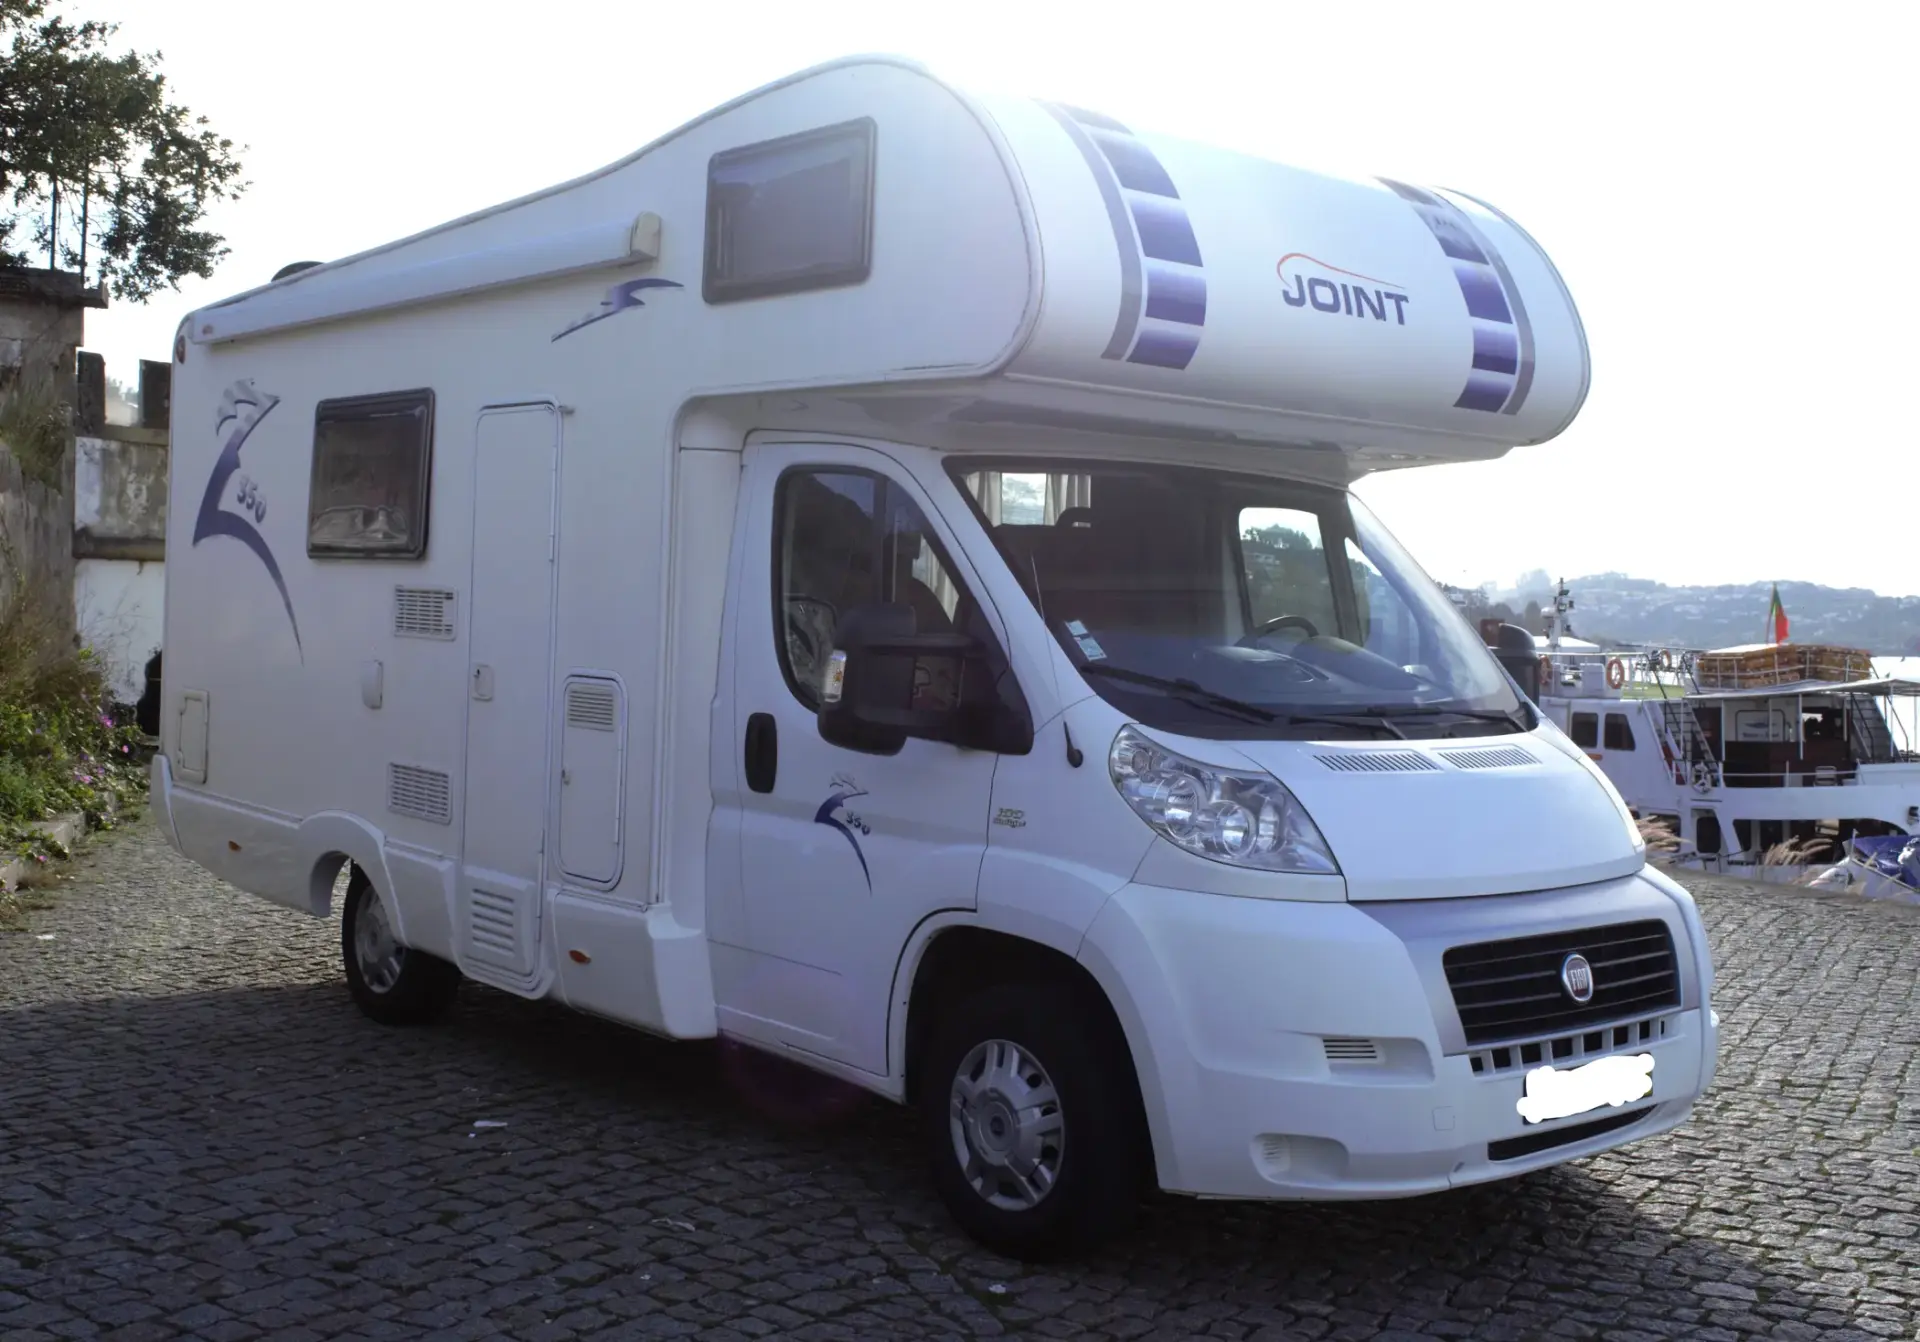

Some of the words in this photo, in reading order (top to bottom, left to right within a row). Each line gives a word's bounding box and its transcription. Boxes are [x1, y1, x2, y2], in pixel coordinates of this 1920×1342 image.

[1282, 274, 1409, 326] JOINT
[237, 474, 267, 524] 350
[846, 811, 871, 836] 350
[1569, 967, 1588, 991] FIAT
